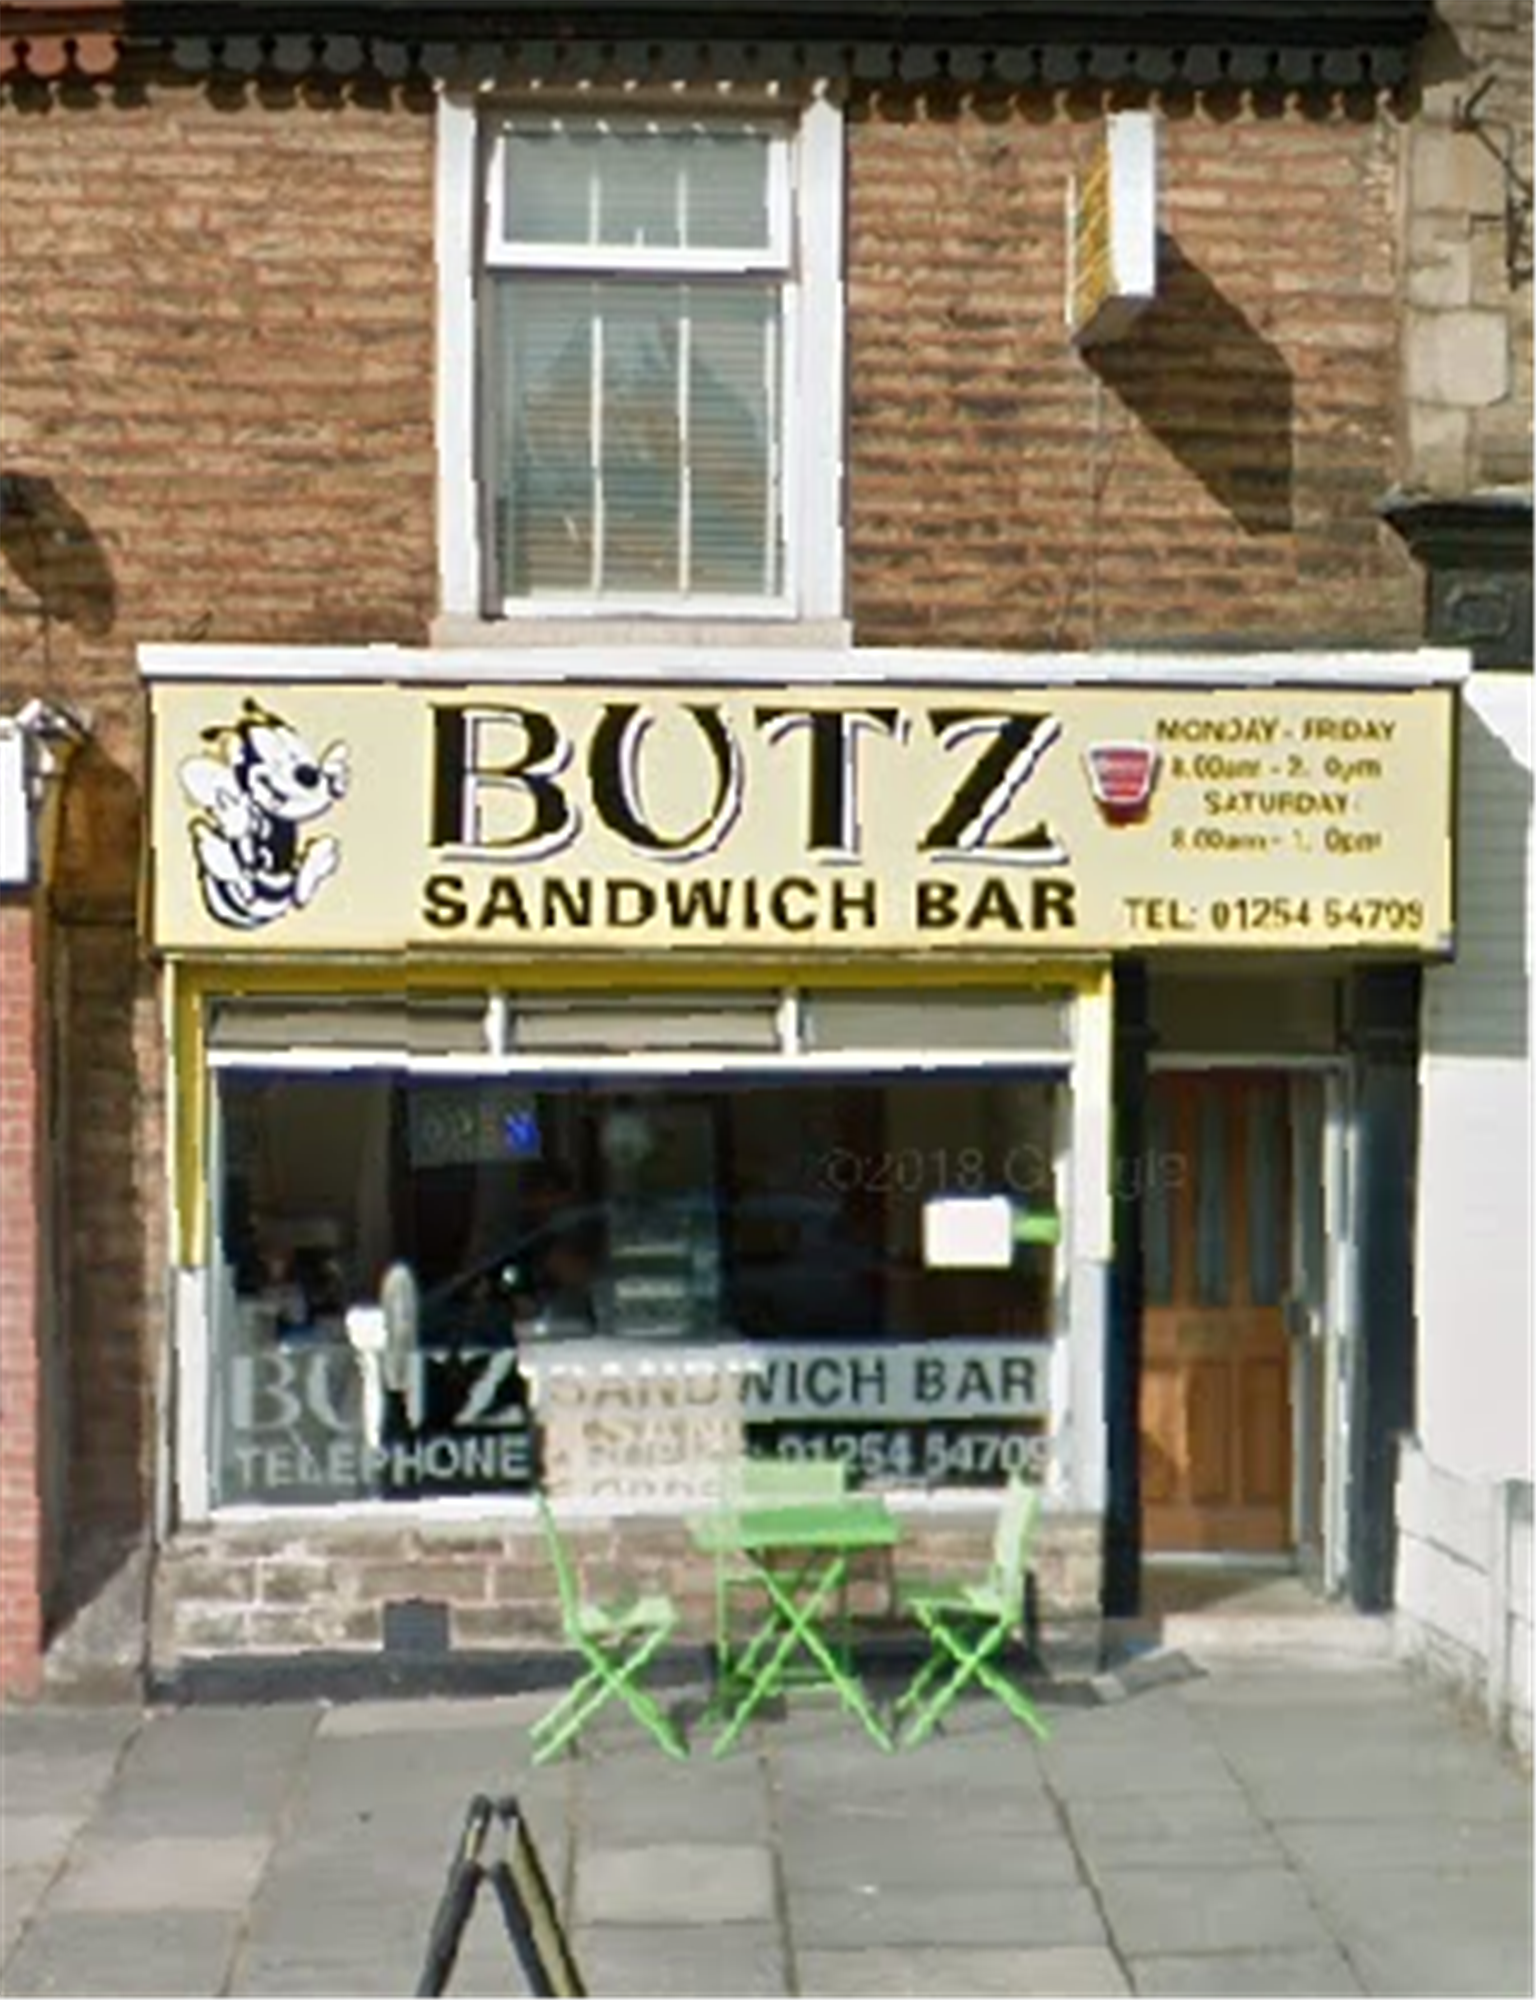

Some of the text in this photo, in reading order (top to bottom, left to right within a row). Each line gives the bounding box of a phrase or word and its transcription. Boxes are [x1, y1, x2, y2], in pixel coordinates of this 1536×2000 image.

[1157, 718, 1278, 742] MONDAY
[1302, 718, 1396, 741] FRIDAY
[428, 703, 1069, 867] BOTZ
[1203, 790, 1349, 815] SATURDAY
[423, 876, 1077, 930] SANDWICH BAR
[1123, 897, 1425, 931] TEL: 01254 54709
[914, 1356, 1036, 1403] BAR
[232, 1436, 532, 1488] TELEPHONE
